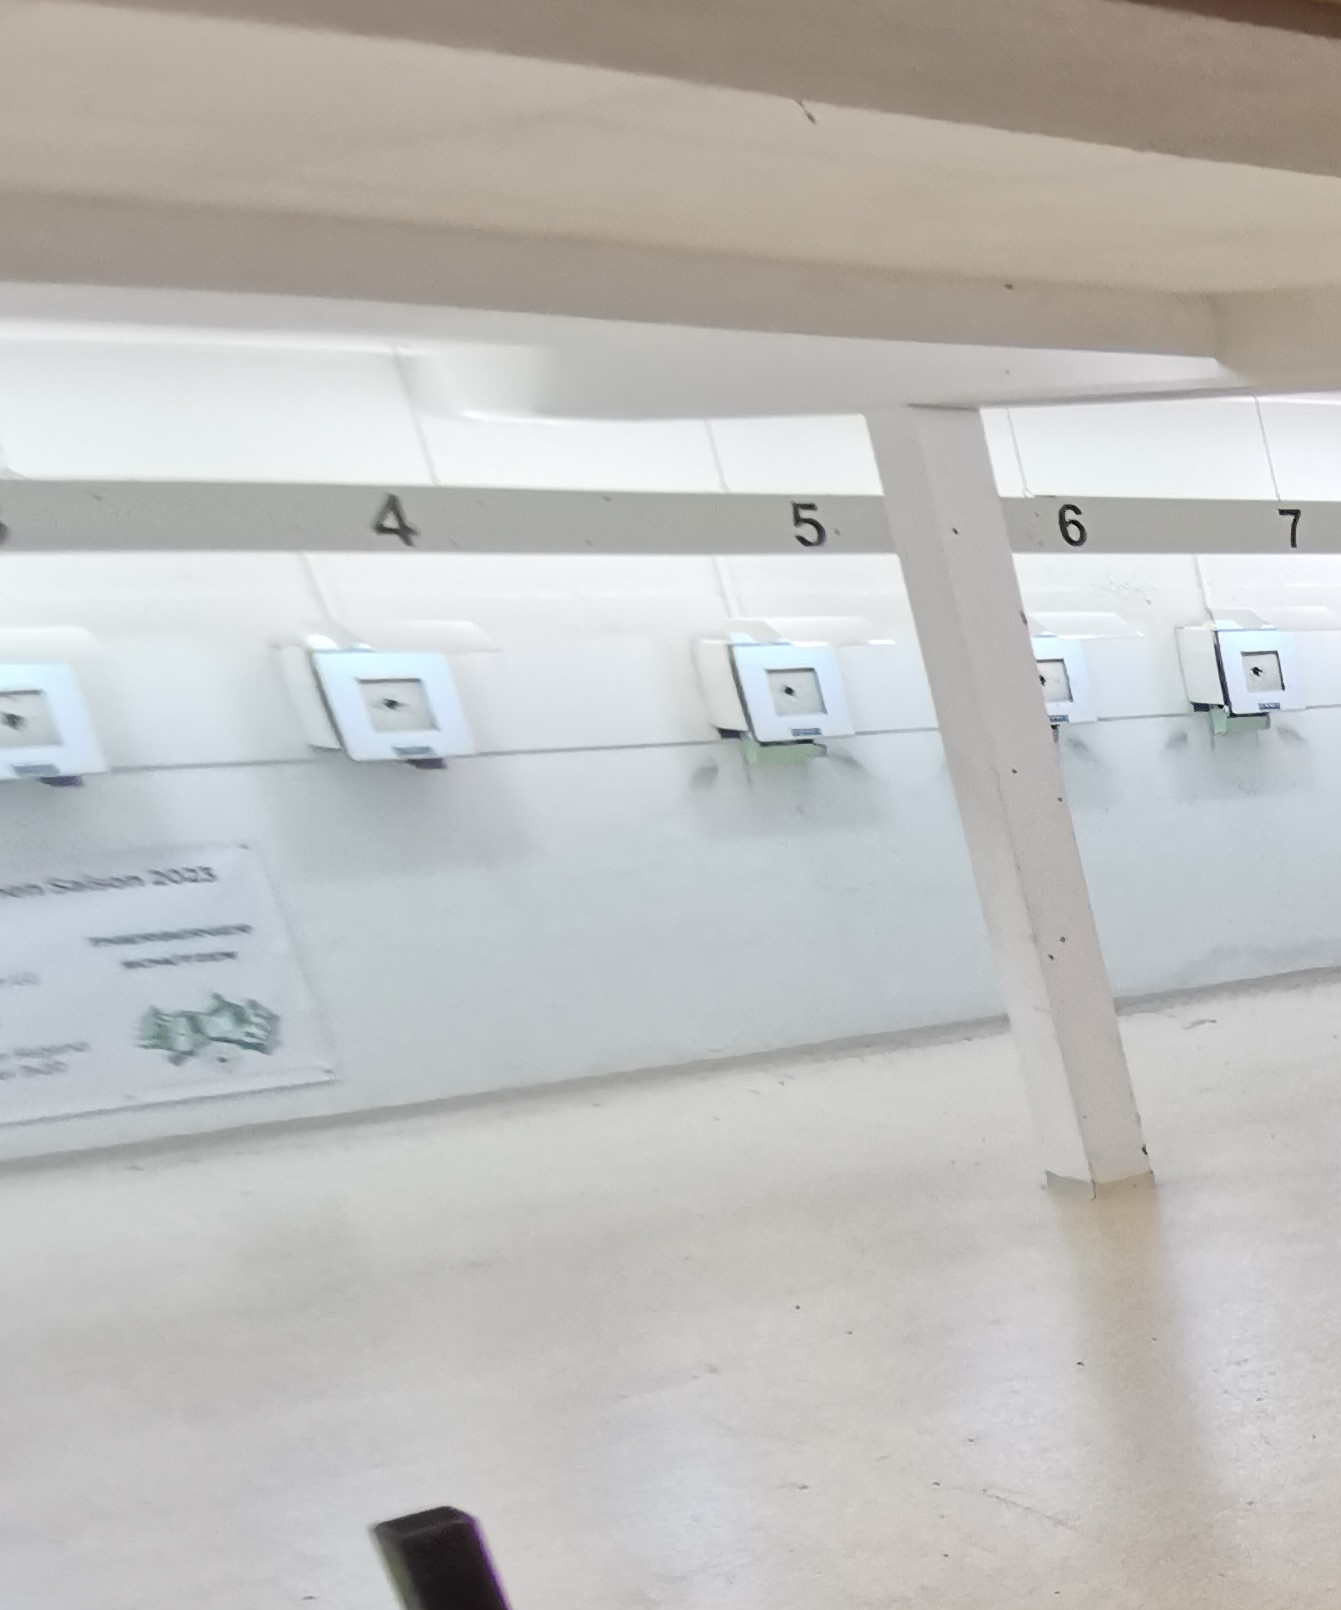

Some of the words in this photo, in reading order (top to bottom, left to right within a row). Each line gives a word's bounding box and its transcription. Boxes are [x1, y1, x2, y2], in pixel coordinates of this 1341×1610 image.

[374, 494, 420, 547] 4
[792, 502, 826, 547] 5
[1058, 503, 1087, 547] 6
[1278, 508, 1301, 549] 7
